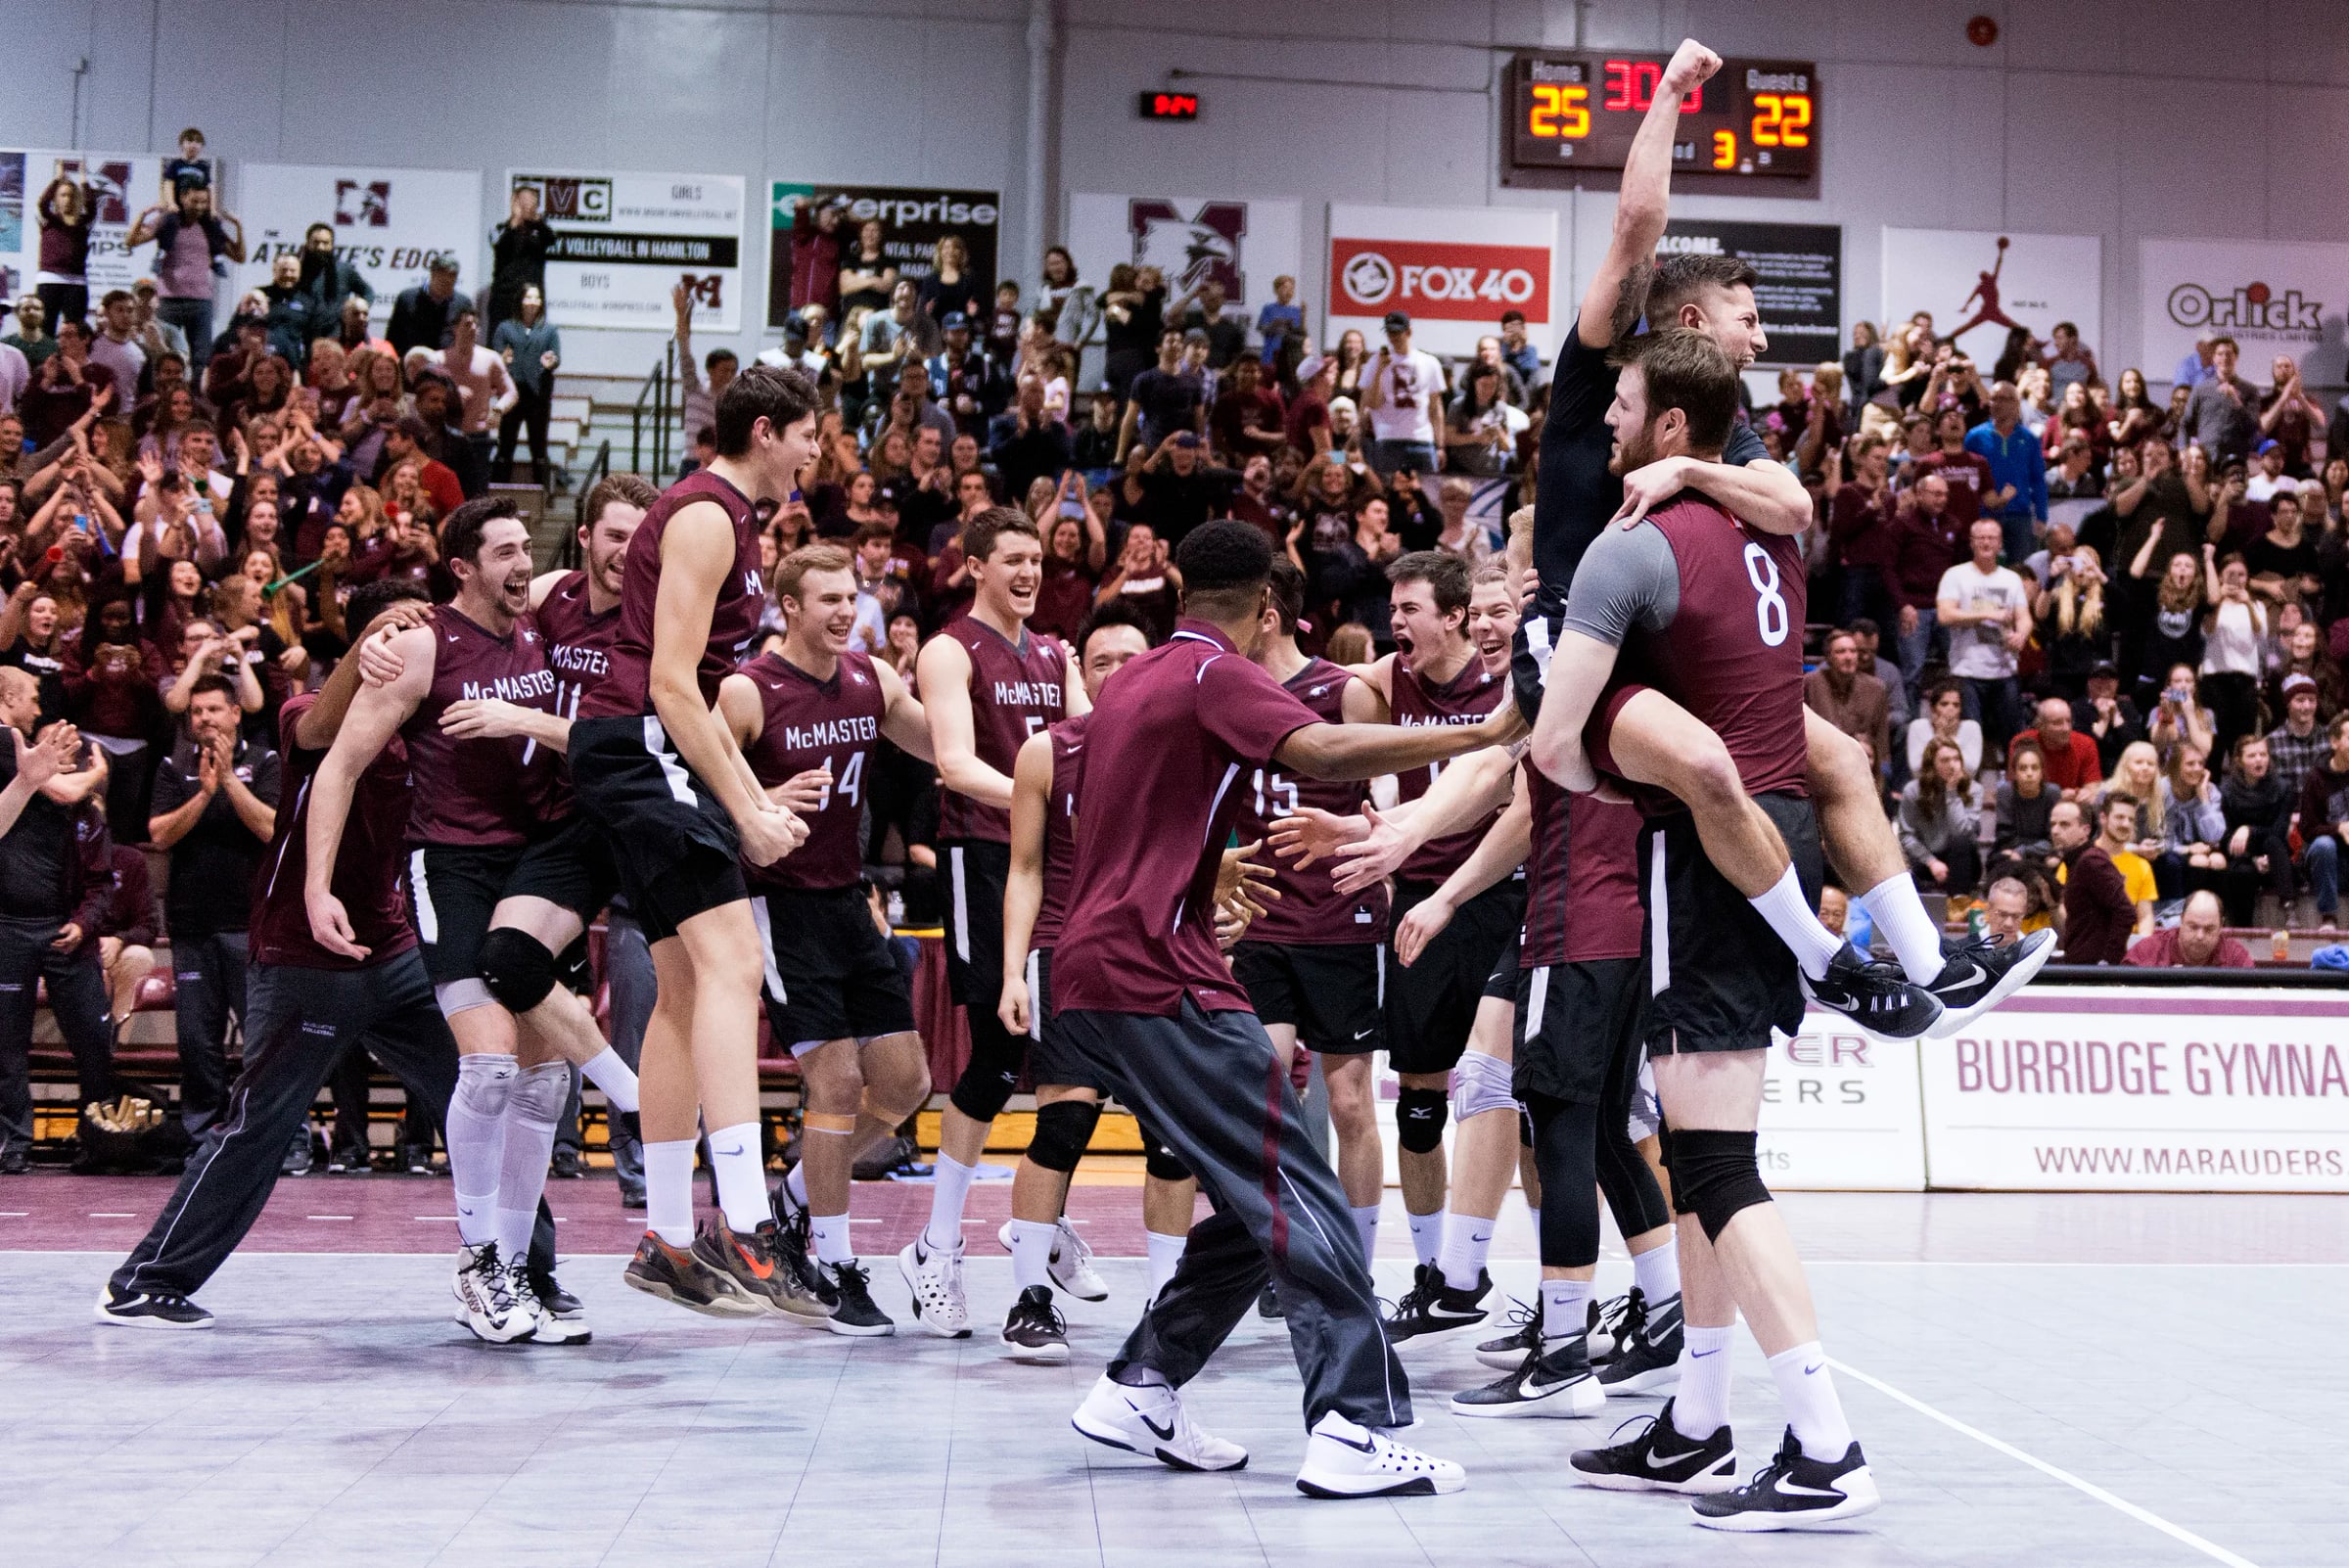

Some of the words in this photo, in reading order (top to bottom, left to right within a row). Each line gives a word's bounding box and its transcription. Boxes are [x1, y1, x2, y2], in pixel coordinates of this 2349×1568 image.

[1530, 84, 1591, 138] 25
[1751, 94, 1812, 147] 22
[1714, 129, 1737, 170] 3
[773, 193, 997, 228] eterprise
[566, 238, 633, 258] VOLLEYBALL
[636, 240, 649, 257] IN
[651, 241, 711, 260] HAMILTON
[2168, 282, 2324, 331] Orlick
[1744, 542, 1789, 647] 8
[785, 715, 878, 751] McMASTER
[819, 751, 865, 812] 14
[1958, 1038, 2171, 1096] BURRIDGE
[2184, 1041, 2349, 1097] GYMNA
[2034, 1146, 2349, 1176] WWW.MARAUDERS
